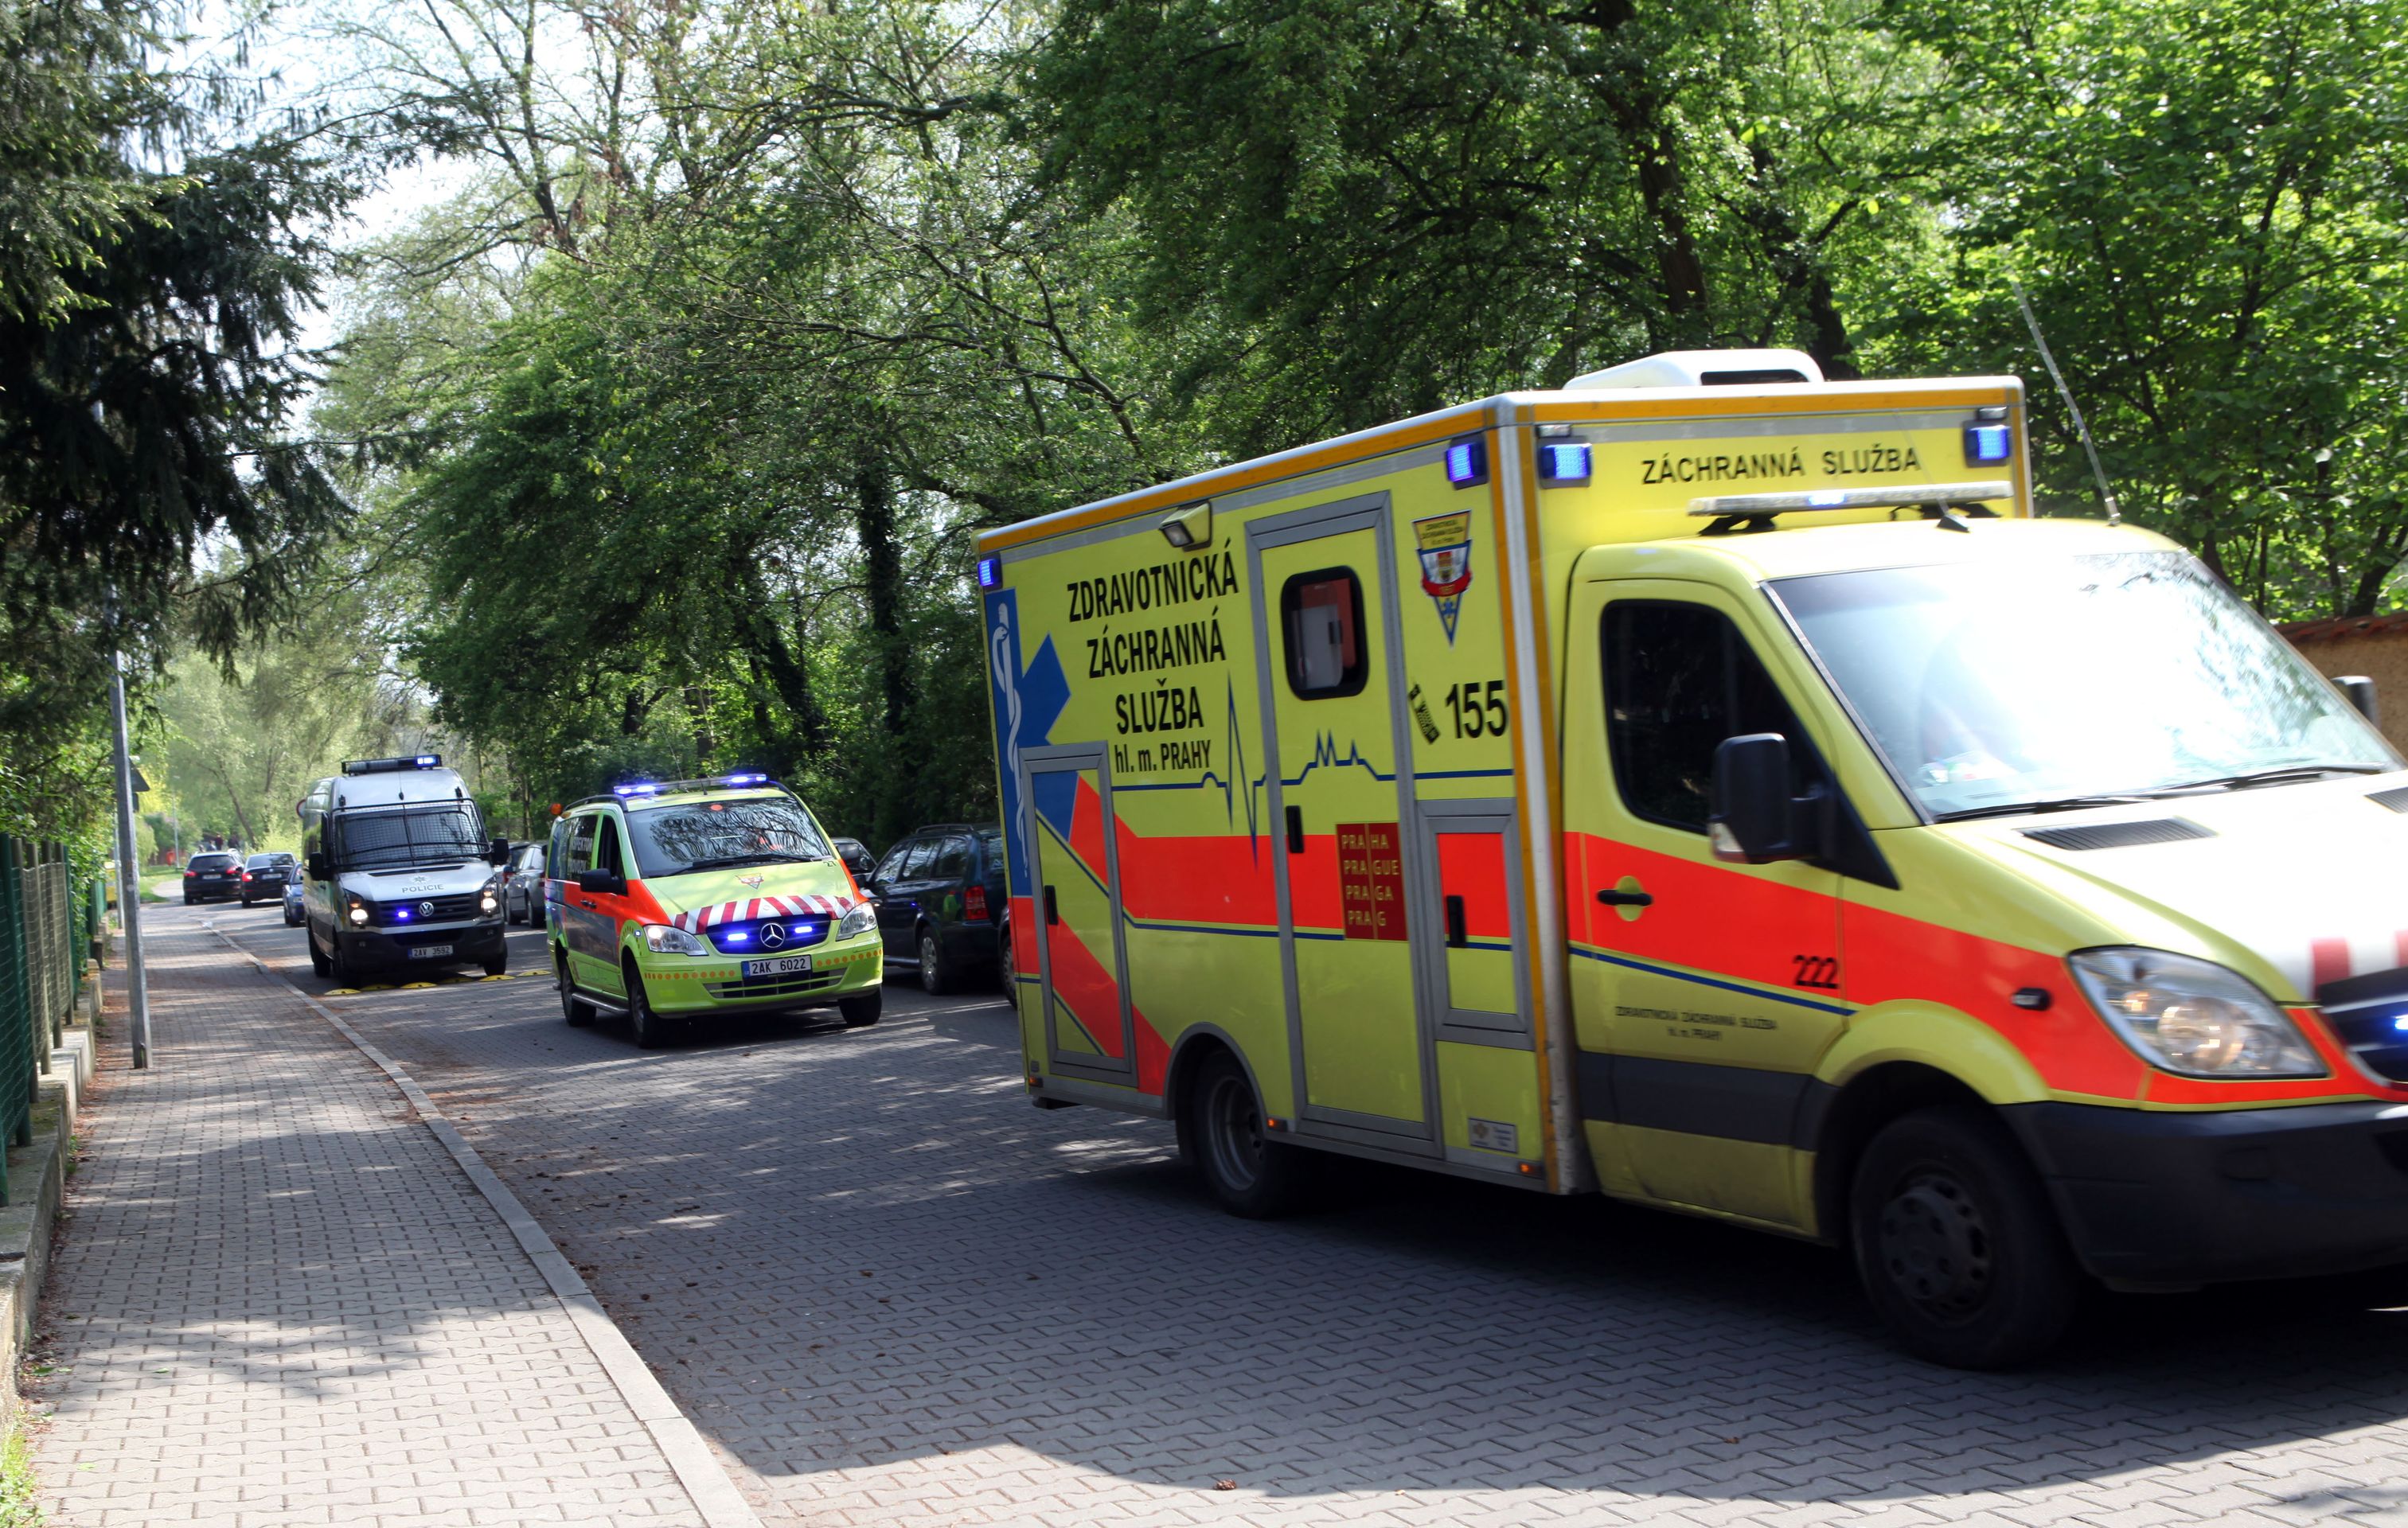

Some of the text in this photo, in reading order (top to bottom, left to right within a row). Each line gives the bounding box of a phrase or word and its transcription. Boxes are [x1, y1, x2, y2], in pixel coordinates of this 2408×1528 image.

[1641, 443, 1922, 485] ZÁCHRANNÁ SLUŽBA
[1067, 536, 1239, 622] ZDRAVOTNICKÁ
[1087, 605, 1226, 678] ZÁCHRANNÁ
[1115, 678, 1204, 735] SLUŽBA
[1445, 680, 1508, 739] 155
[1114, 739, 1211, 773] hl. m. PRAHY
[402, 883, 444, 893] POLICIE
[752, 958, 806, 973] 2AK 6022
[1792, 955, 1839, 989] 222
